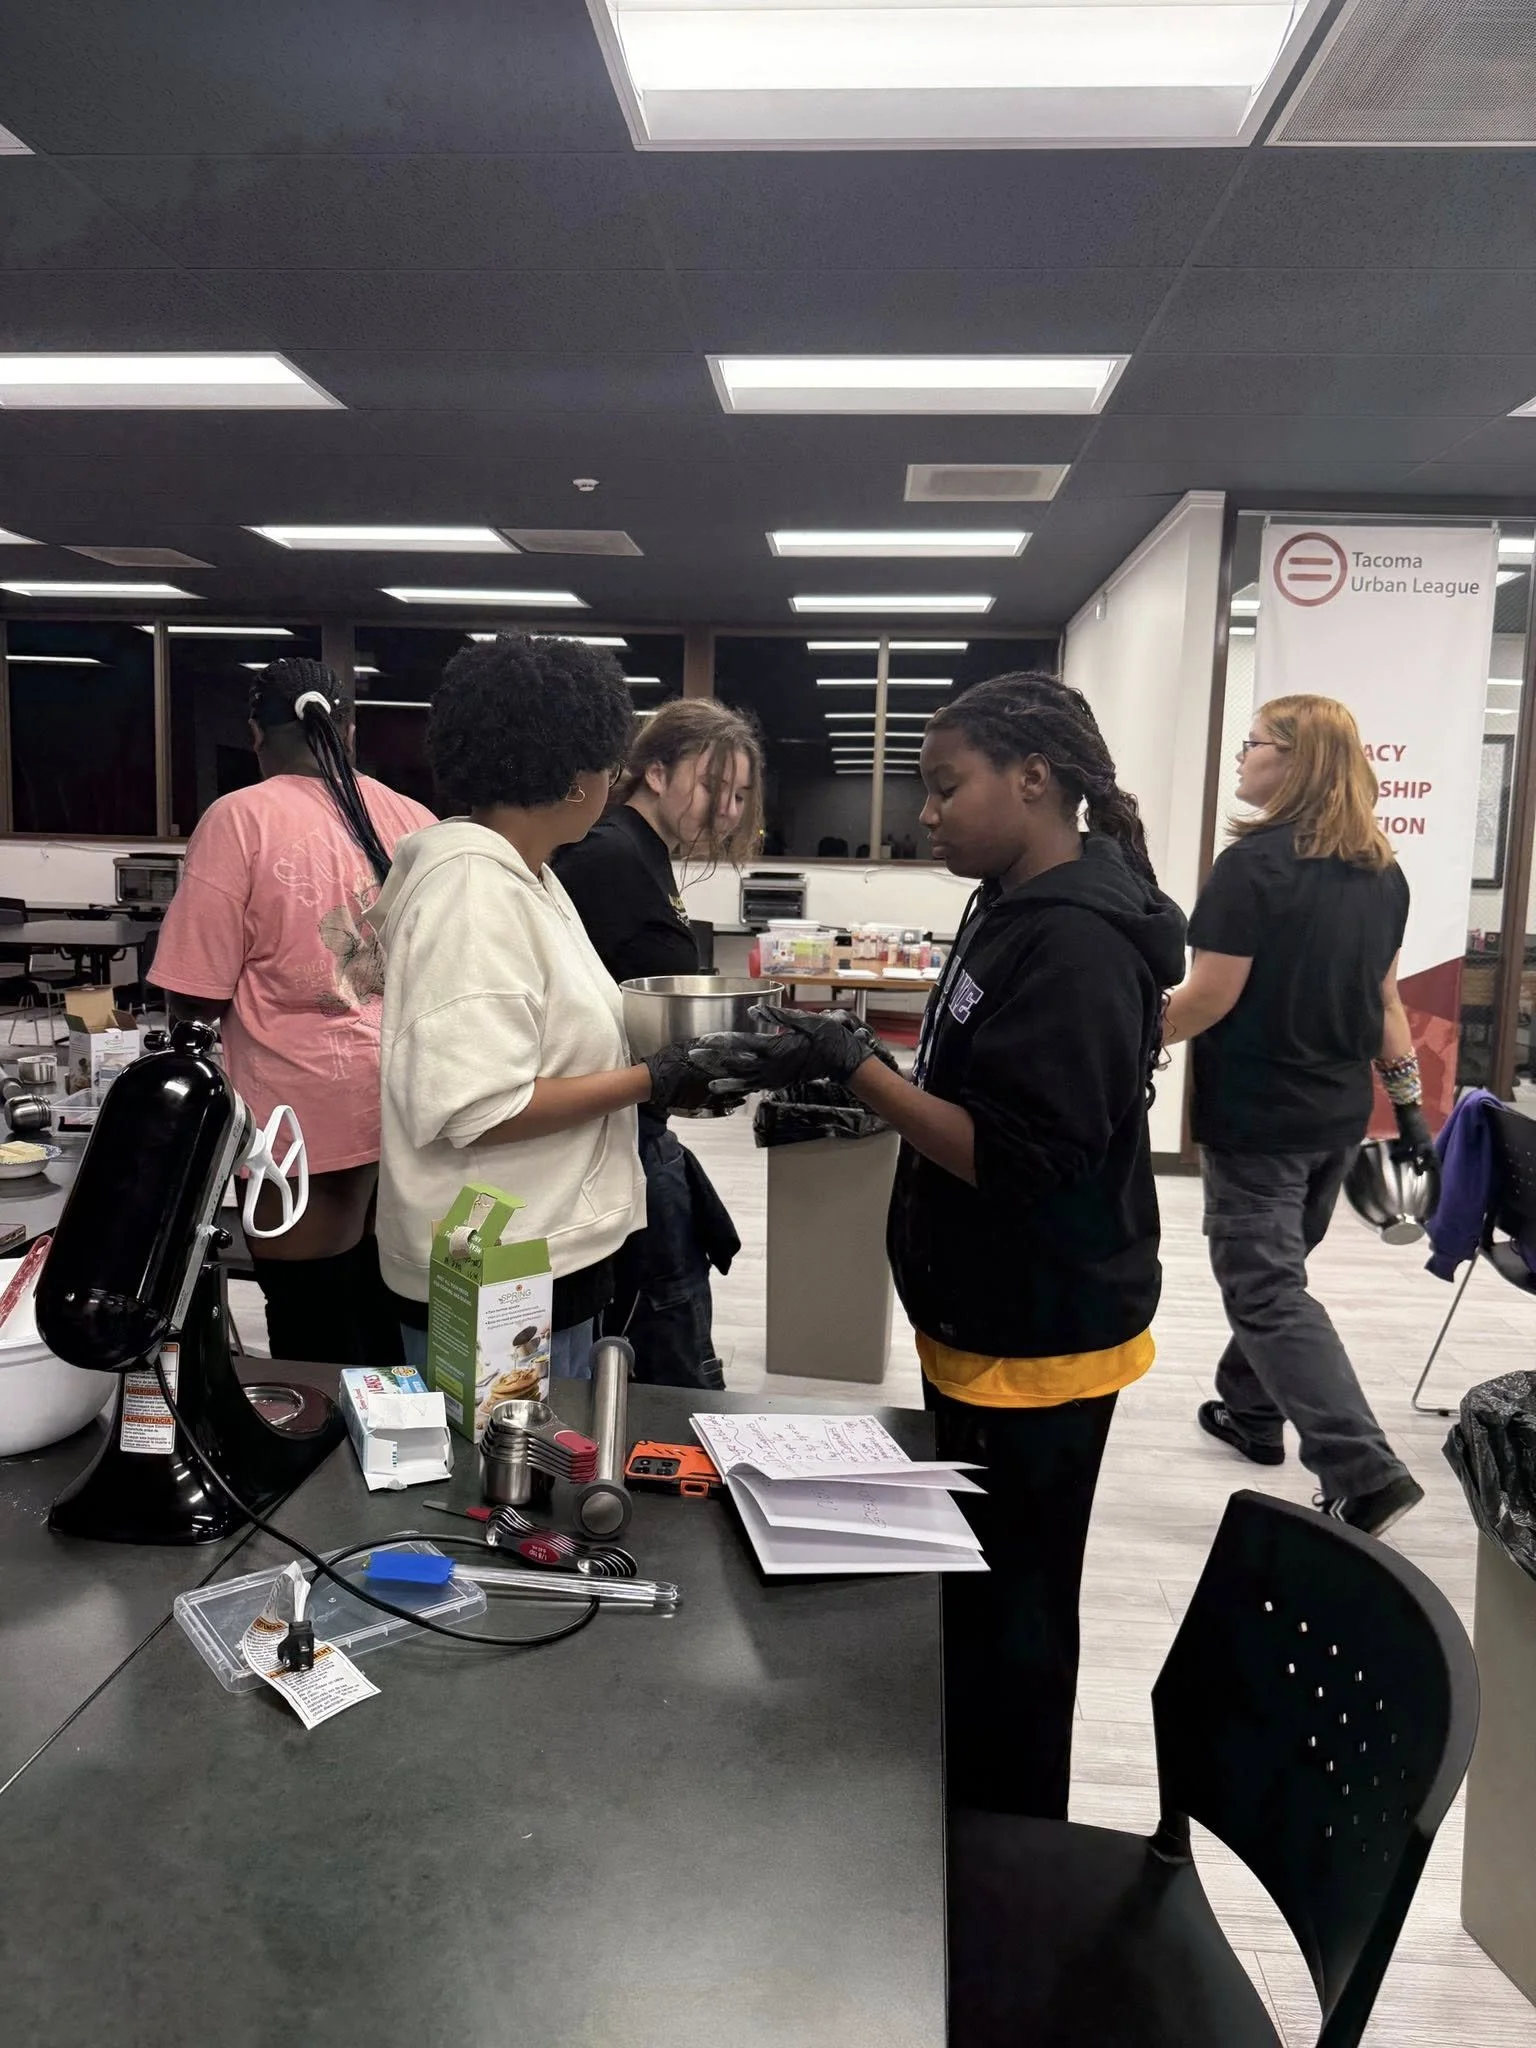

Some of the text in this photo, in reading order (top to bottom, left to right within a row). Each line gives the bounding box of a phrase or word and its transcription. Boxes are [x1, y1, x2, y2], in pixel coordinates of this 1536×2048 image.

[1352, 552, 1423, 568] Tacoma
[1351, 576, 1480, 598] Urban League
